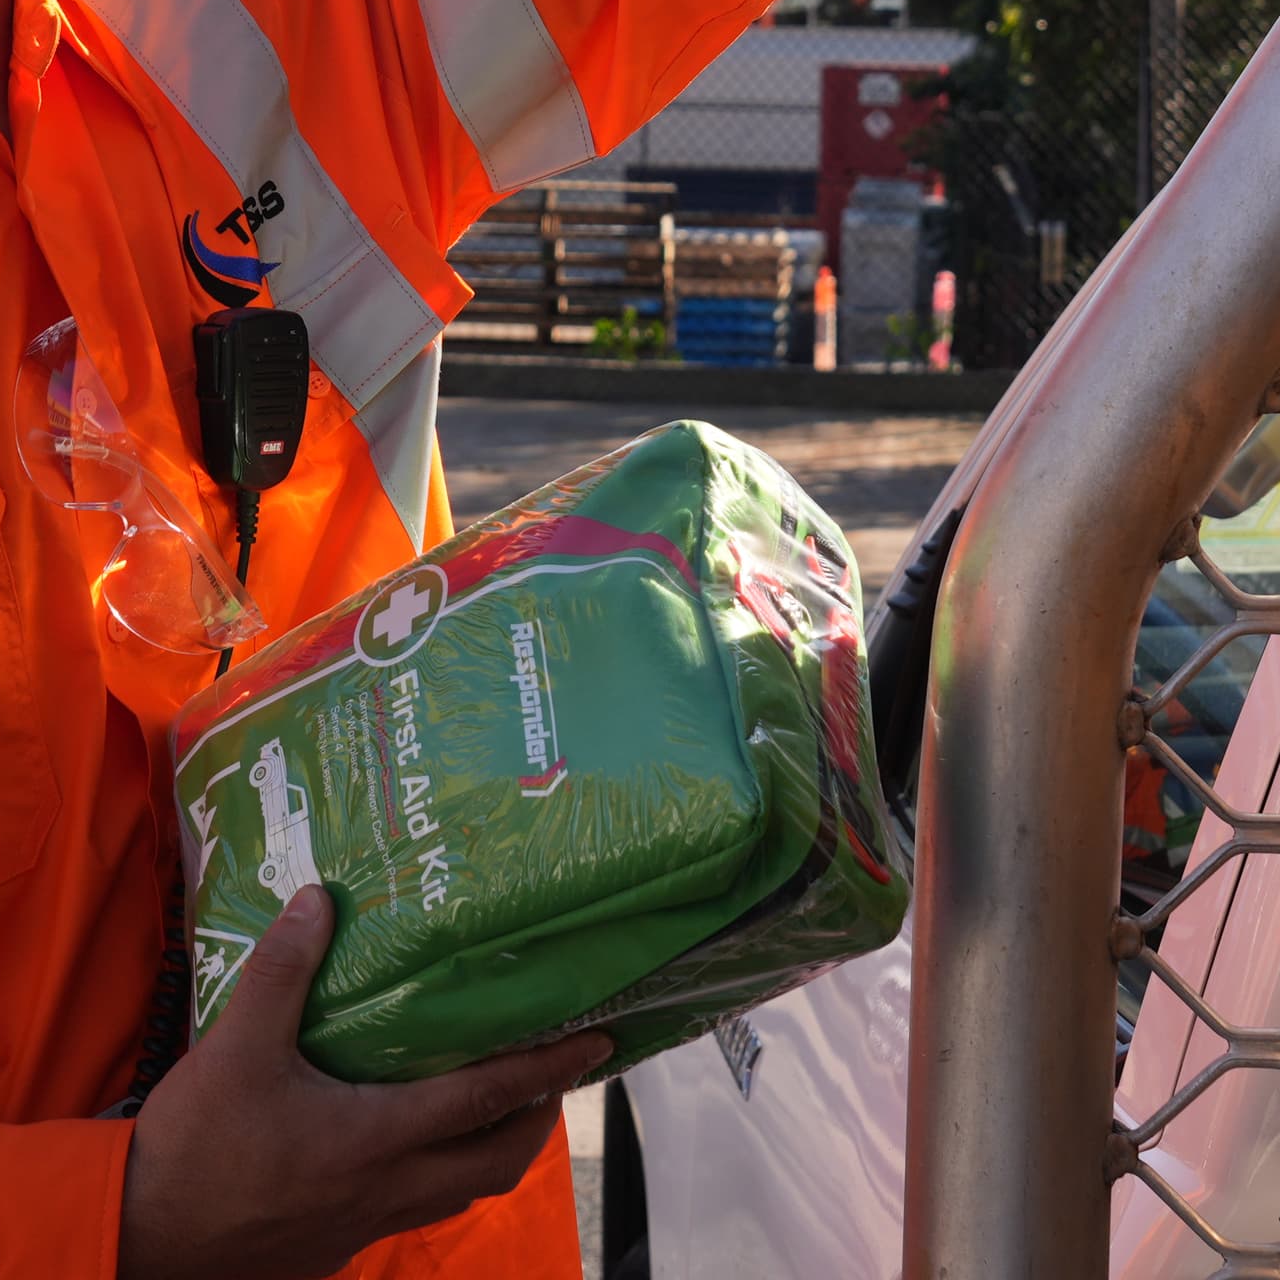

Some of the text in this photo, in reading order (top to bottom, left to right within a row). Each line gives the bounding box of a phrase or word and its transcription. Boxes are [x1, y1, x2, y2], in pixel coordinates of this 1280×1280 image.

[215, 179, 285, 246] T&S
[359, 691, 370, 741] Complies
[372, 820, 386, 851] Code
[509, 621, 552, 773] Responder
[390, 669, 450, 912] First Aid Kit
